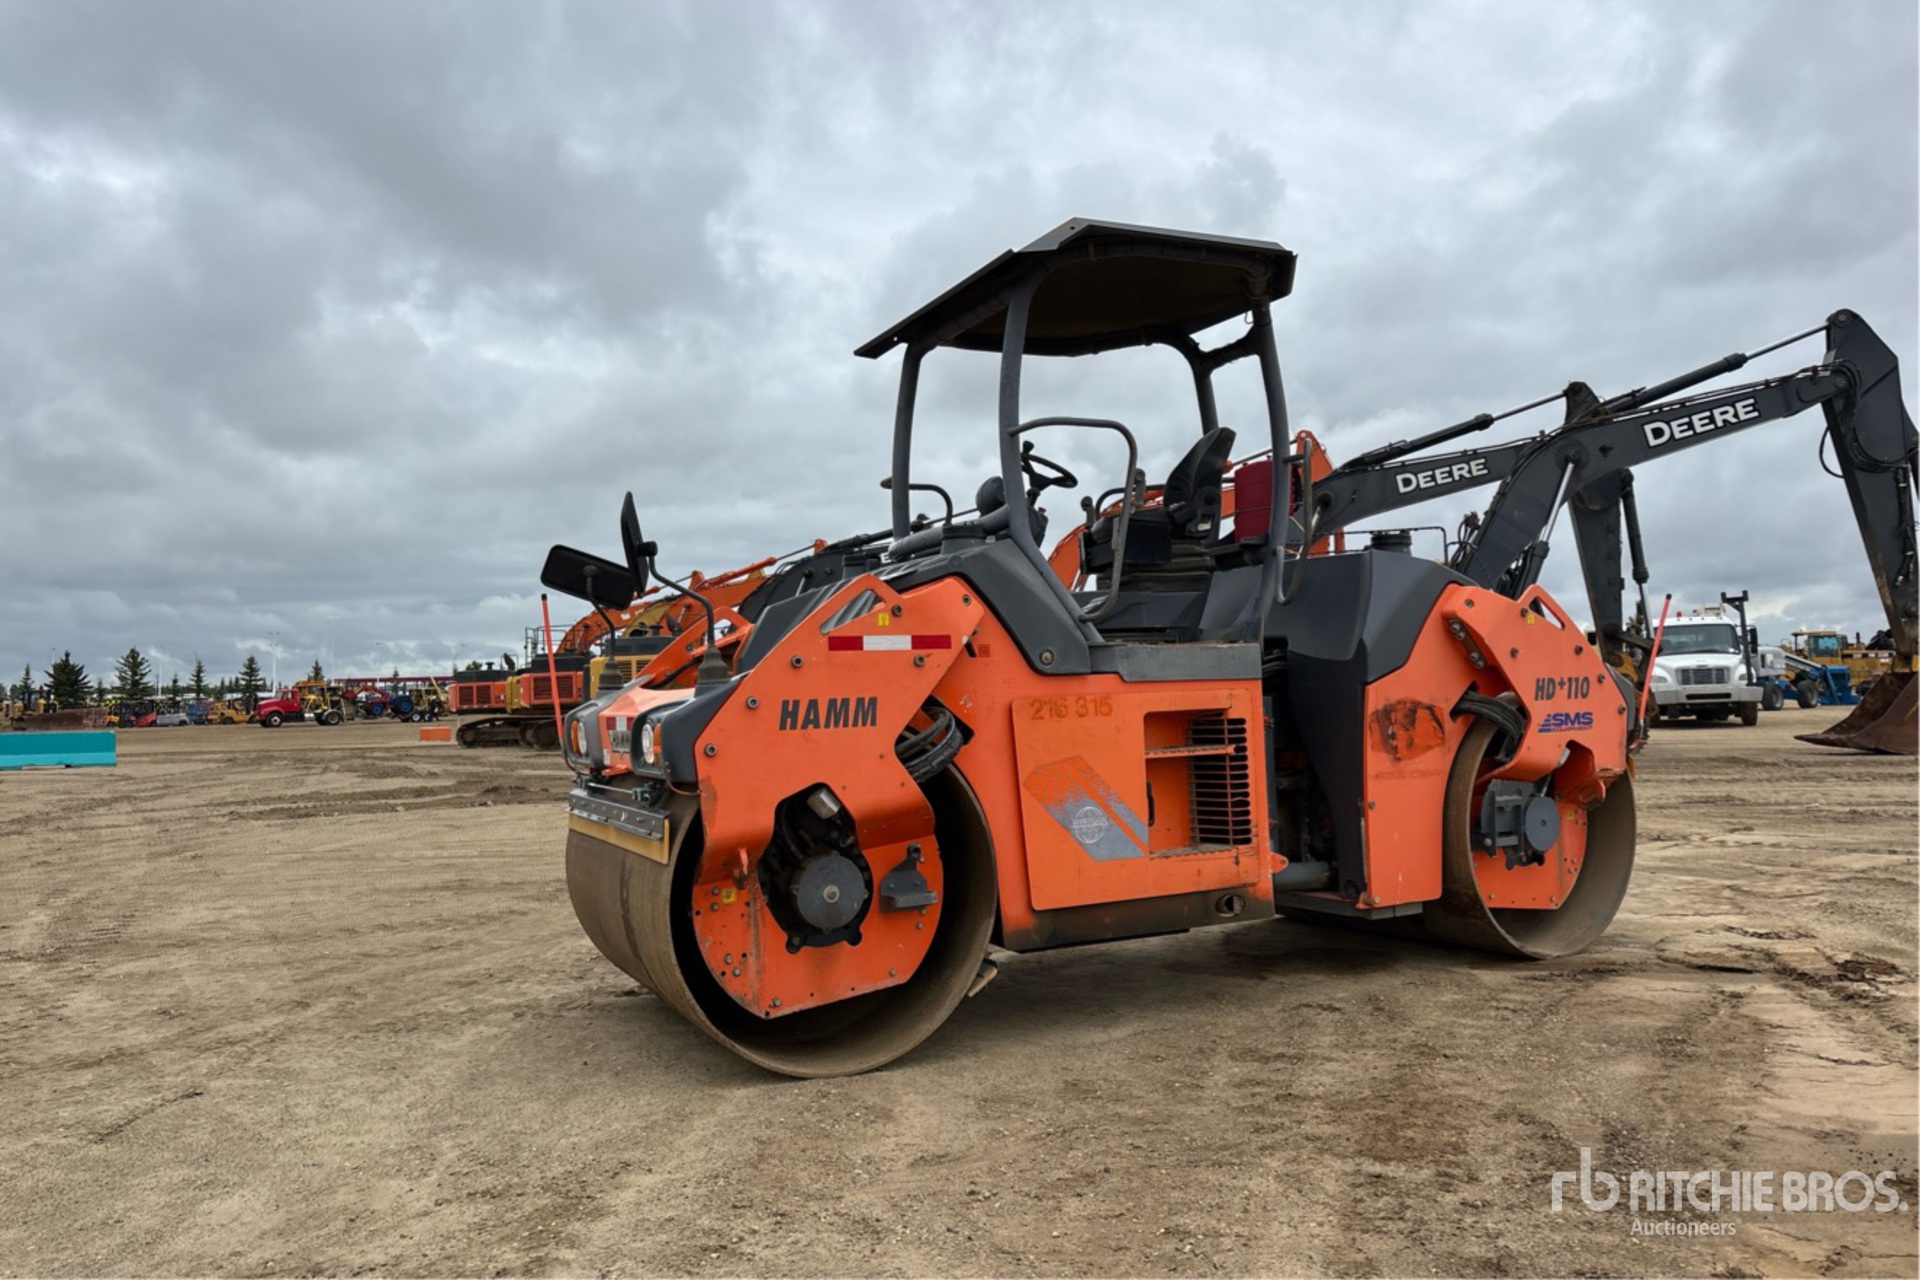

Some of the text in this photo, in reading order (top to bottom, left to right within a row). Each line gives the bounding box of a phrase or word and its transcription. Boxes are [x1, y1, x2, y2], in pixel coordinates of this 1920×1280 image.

[1642, 398, 1761, 447] DEERE
[1396, 458, 1488, 494] DEERE
[779, 696, 878, 731] HAMM
[1030, 695, 1113, 721] 216 315
[1552, 711, 1594, 727] SMS
